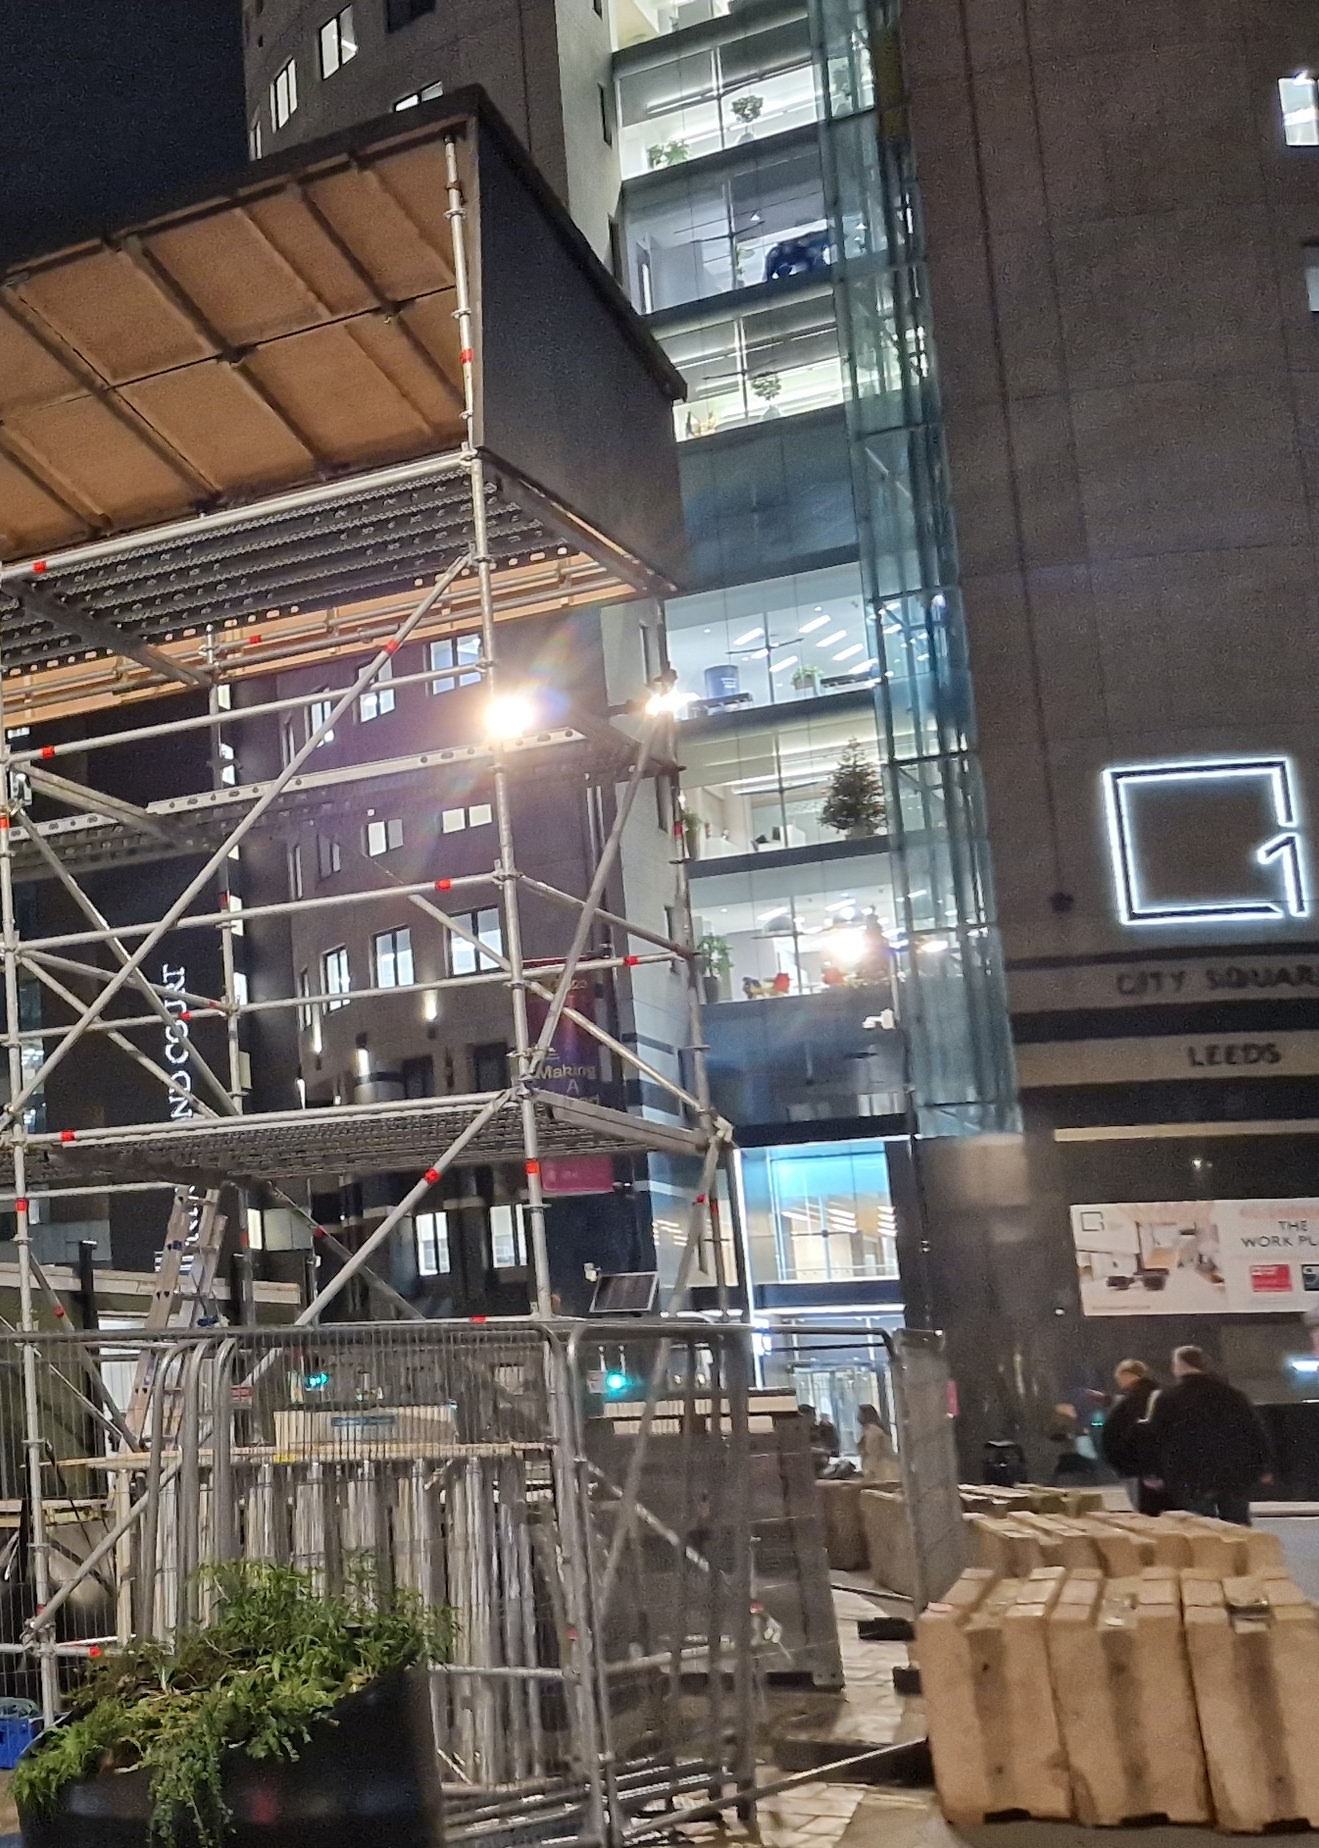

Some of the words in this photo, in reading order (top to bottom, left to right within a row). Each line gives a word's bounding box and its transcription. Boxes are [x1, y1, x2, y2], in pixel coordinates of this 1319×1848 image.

[1118, 972, 1184, 994] CITY
[1207, 965, 1319, 989] SQUAR
[1189, 1043, 1281, 1066] LEEDS
[538, 1064, 596, 1080] Making
[566, 1078, 580, 1095] A
[1278, 1220, 1309, 1232] THE
[1241, 1235, 1292, 1248] WORK
[1299, 1234, 1319, 1247] PL
